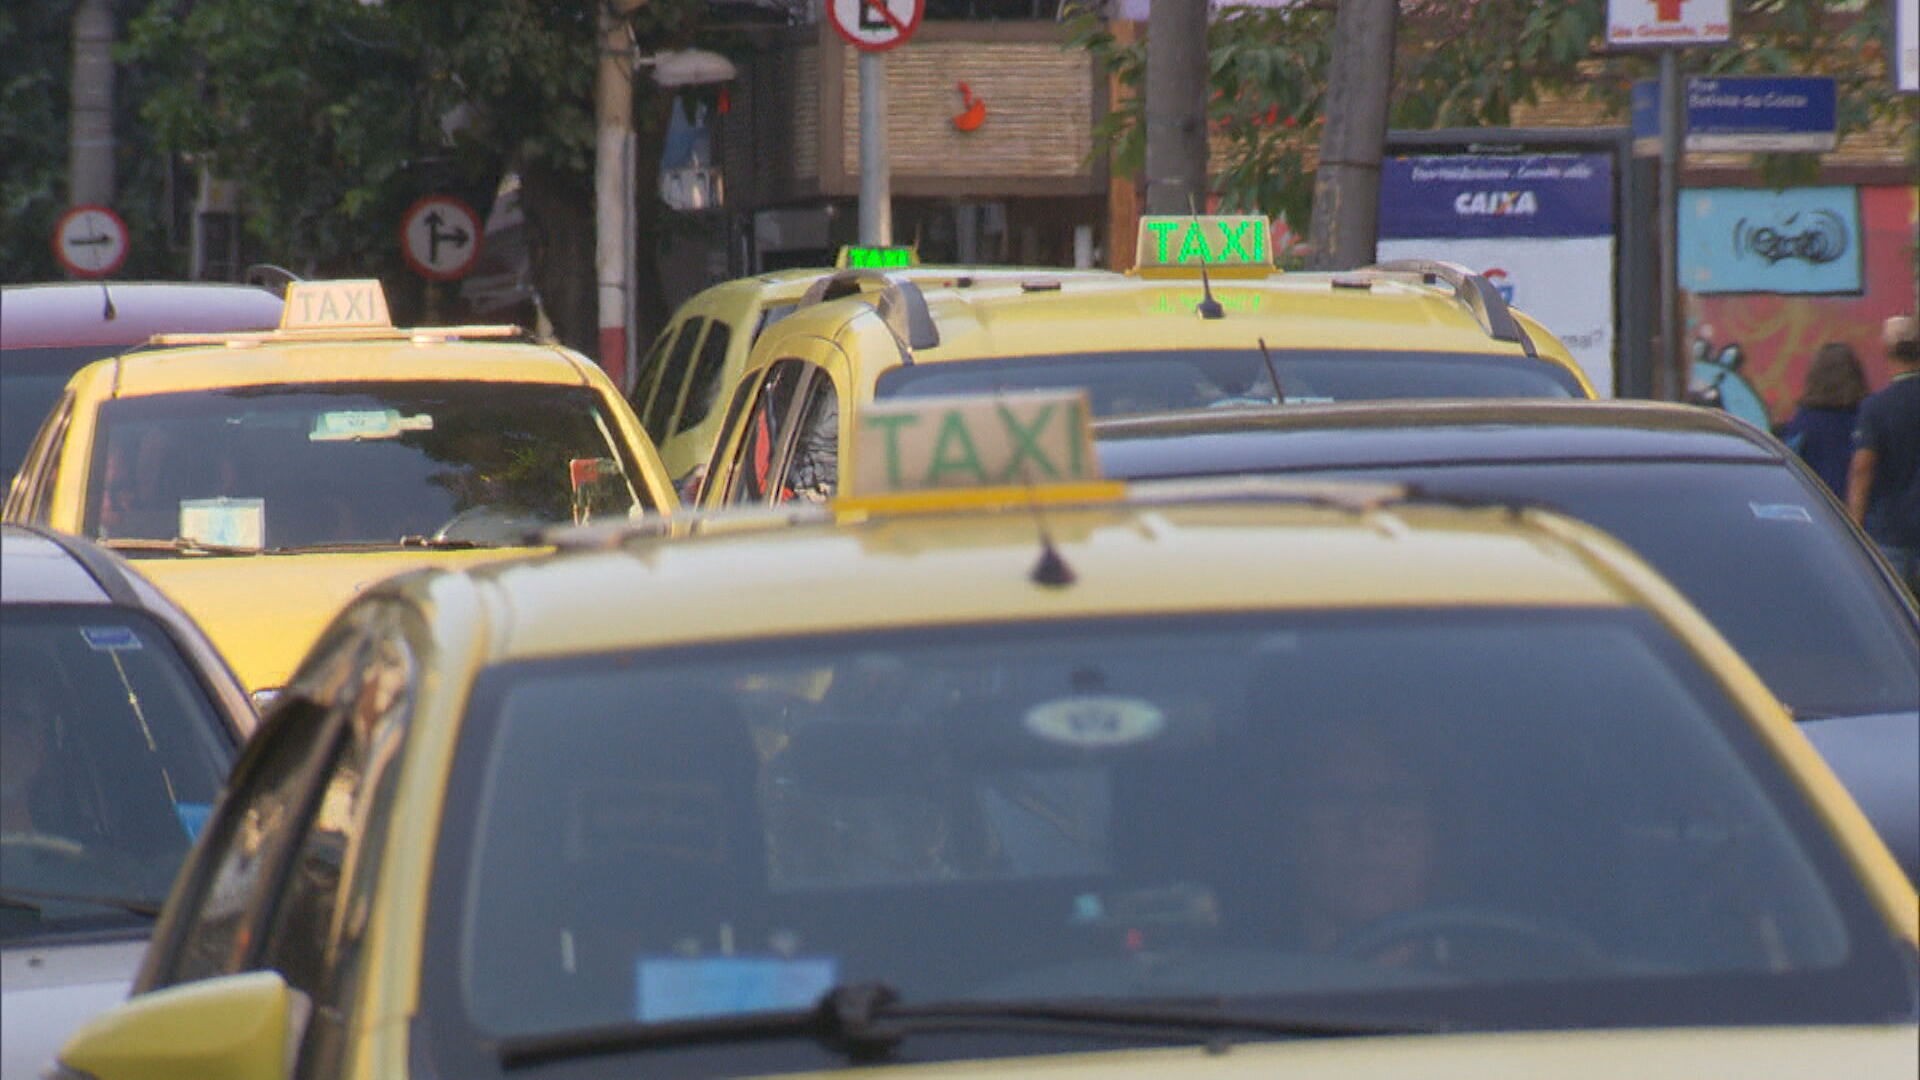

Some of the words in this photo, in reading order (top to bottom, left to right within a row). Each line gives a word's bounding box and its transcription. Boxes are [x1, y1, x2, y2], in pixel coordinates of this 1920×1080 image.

[1455, 191, 1538, 215] CAIXA
[849, 247, 911, 268] TAXI
[1147, 220, 1264, 263] TAXI
[296, 288, 376, 321] TAXI
[863, 402, 1084, 488] TAXI
